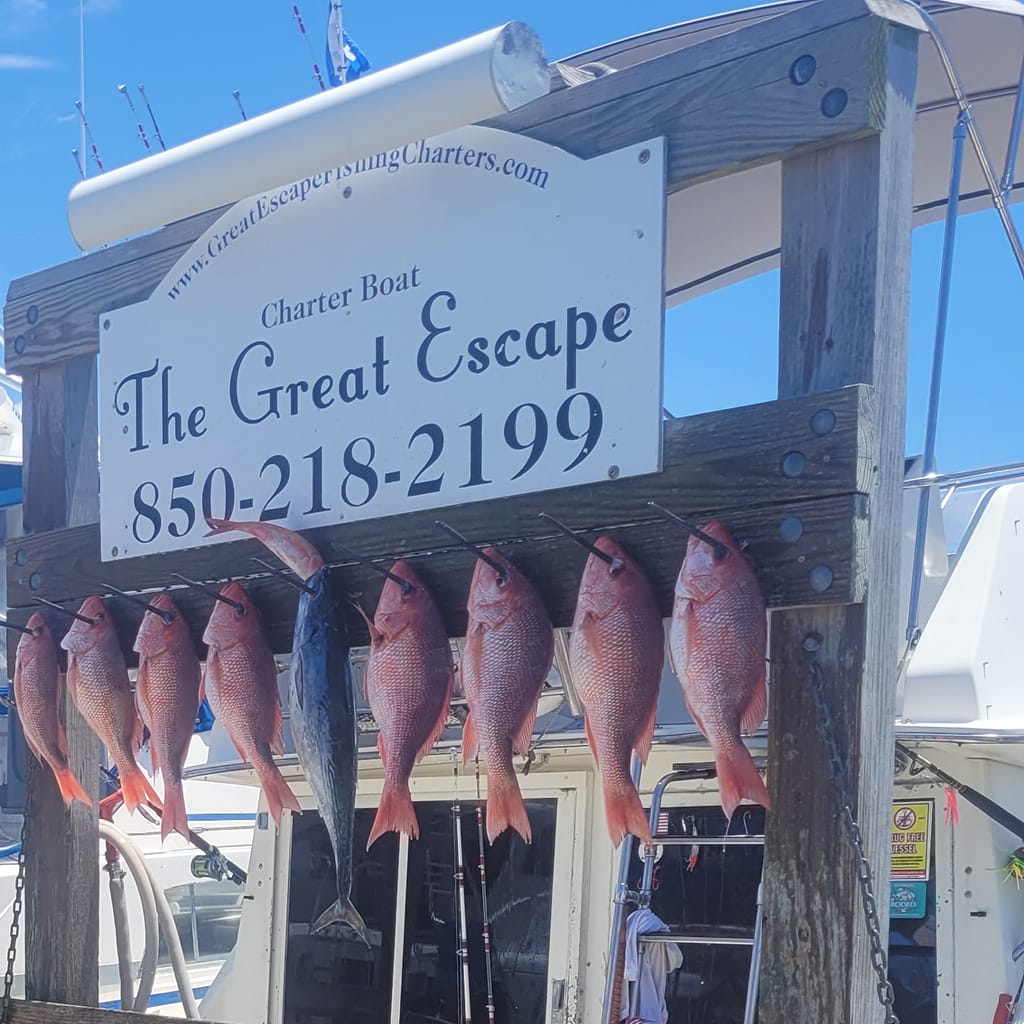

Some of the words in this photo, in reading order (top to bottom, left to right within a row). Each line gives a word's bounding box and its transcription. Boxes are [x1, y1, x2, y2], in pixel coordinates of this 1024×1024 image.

[260, 284, 353, 330] Charter
[360, 264, 422, 299] Boat
[114, 358, 208, 453] The
[229, 336, 390, 425] Great
[416, 290, 634, 391] Escape
[132, 391, 604, 544] 850-218-2199
[907, 832, 925, 842] FREE
